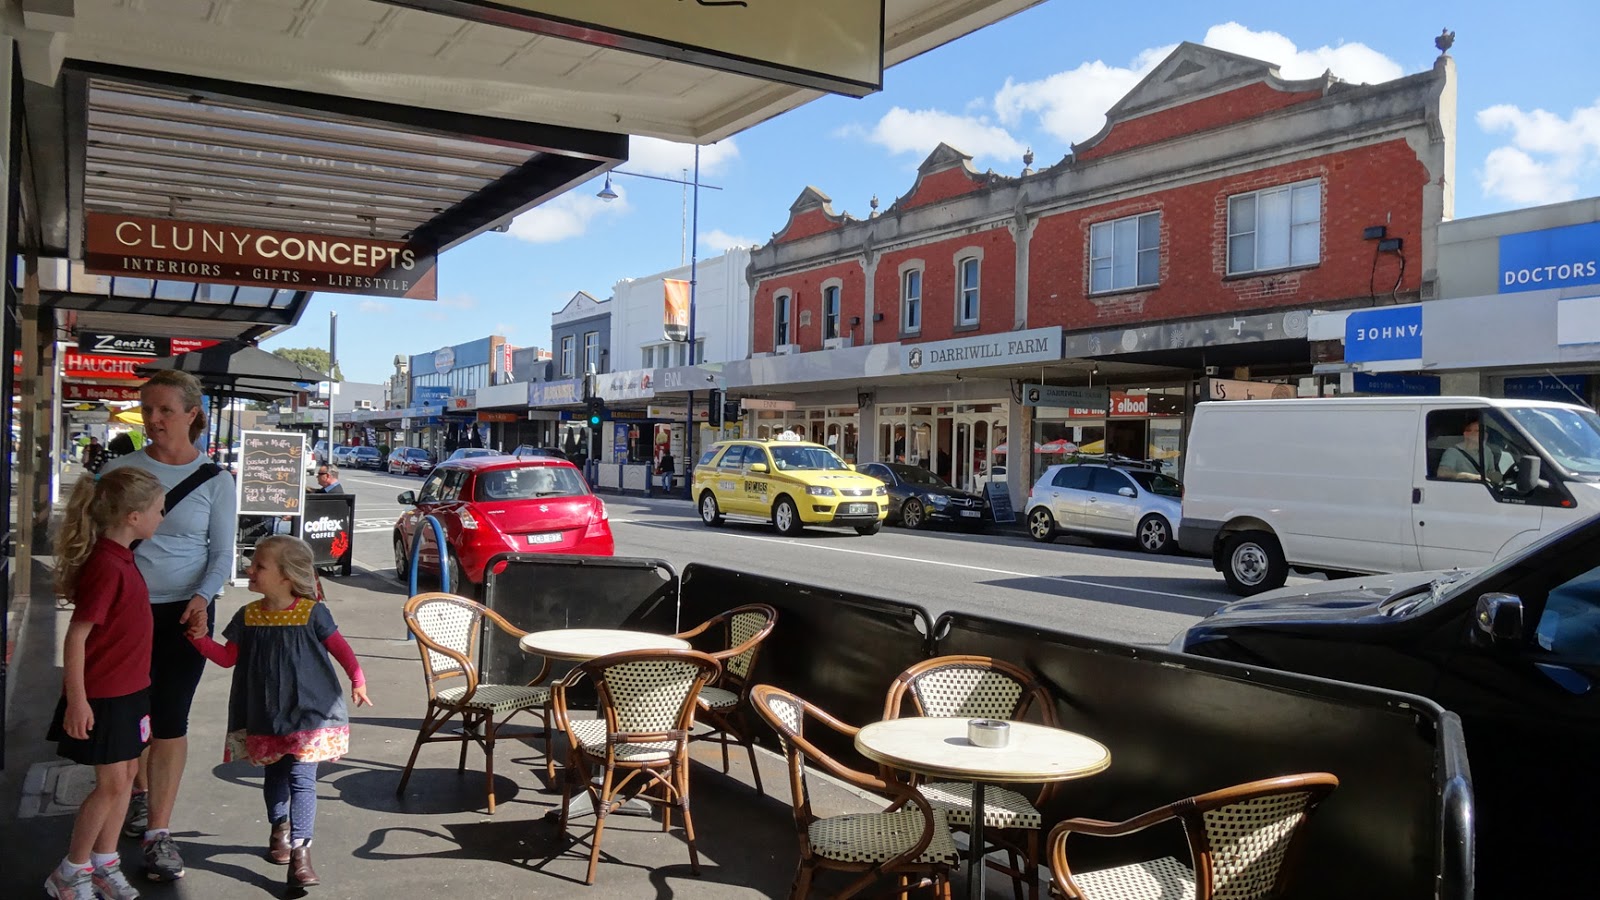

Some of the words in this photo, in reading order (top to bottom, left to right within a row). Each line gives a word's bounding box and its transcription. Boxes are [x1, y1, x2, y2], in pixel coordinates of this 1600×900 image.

[122, 257, 221, 278] INTERIORS
[252, 267, 301, 283] GIFTS
[328, 274, 409, 291] LIFESTYLE
[1505, 261, 1596, 285] DOCTORS
[930, 343, 1002, 363] DARRIWILL
[1007, 337, 1048, 355] FARM
[68, 355, 144, 374] HAUGHTO
[1046, 389, 1083, 398] DARRIWILL
[304, 516, 343, 532] coffex
